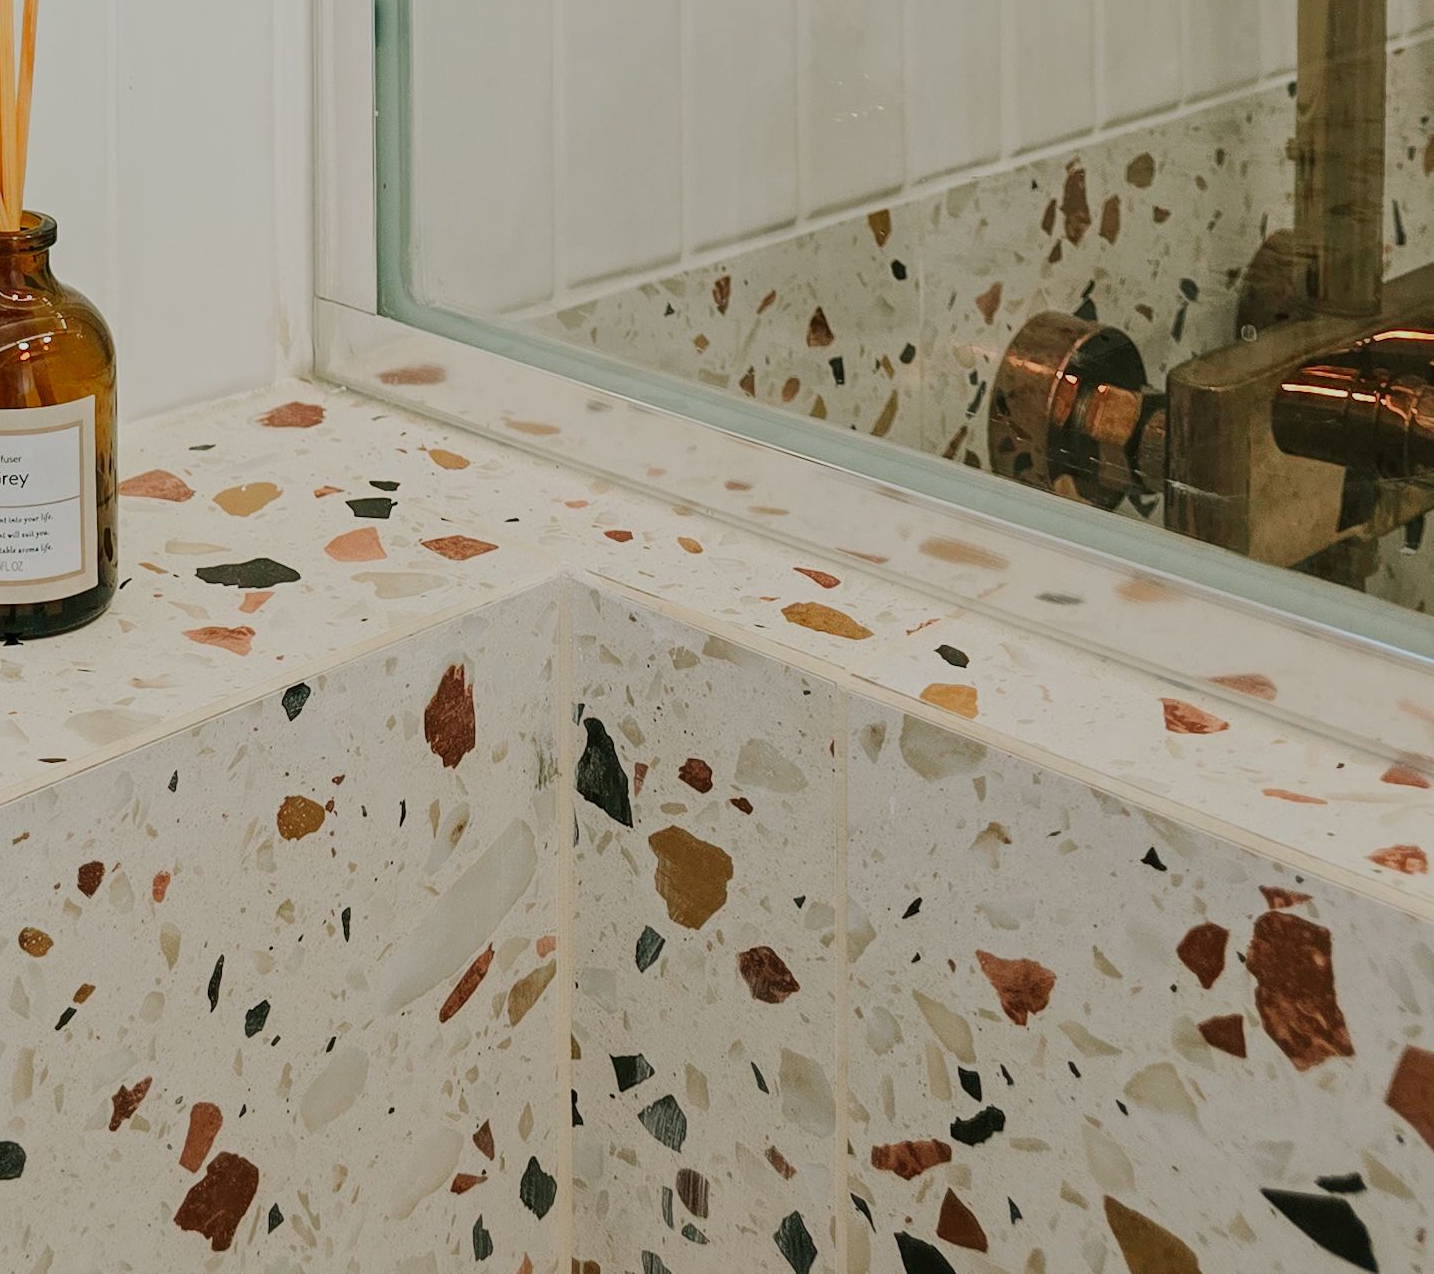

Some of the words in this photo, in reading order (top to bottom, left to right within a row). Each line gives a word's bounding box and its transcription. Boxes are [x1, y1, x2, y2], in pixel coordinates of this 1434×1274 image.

[24, 516, 39, 524] your
[7, 530, 19, 538] will
[11, 560, 24, 571] OZ
